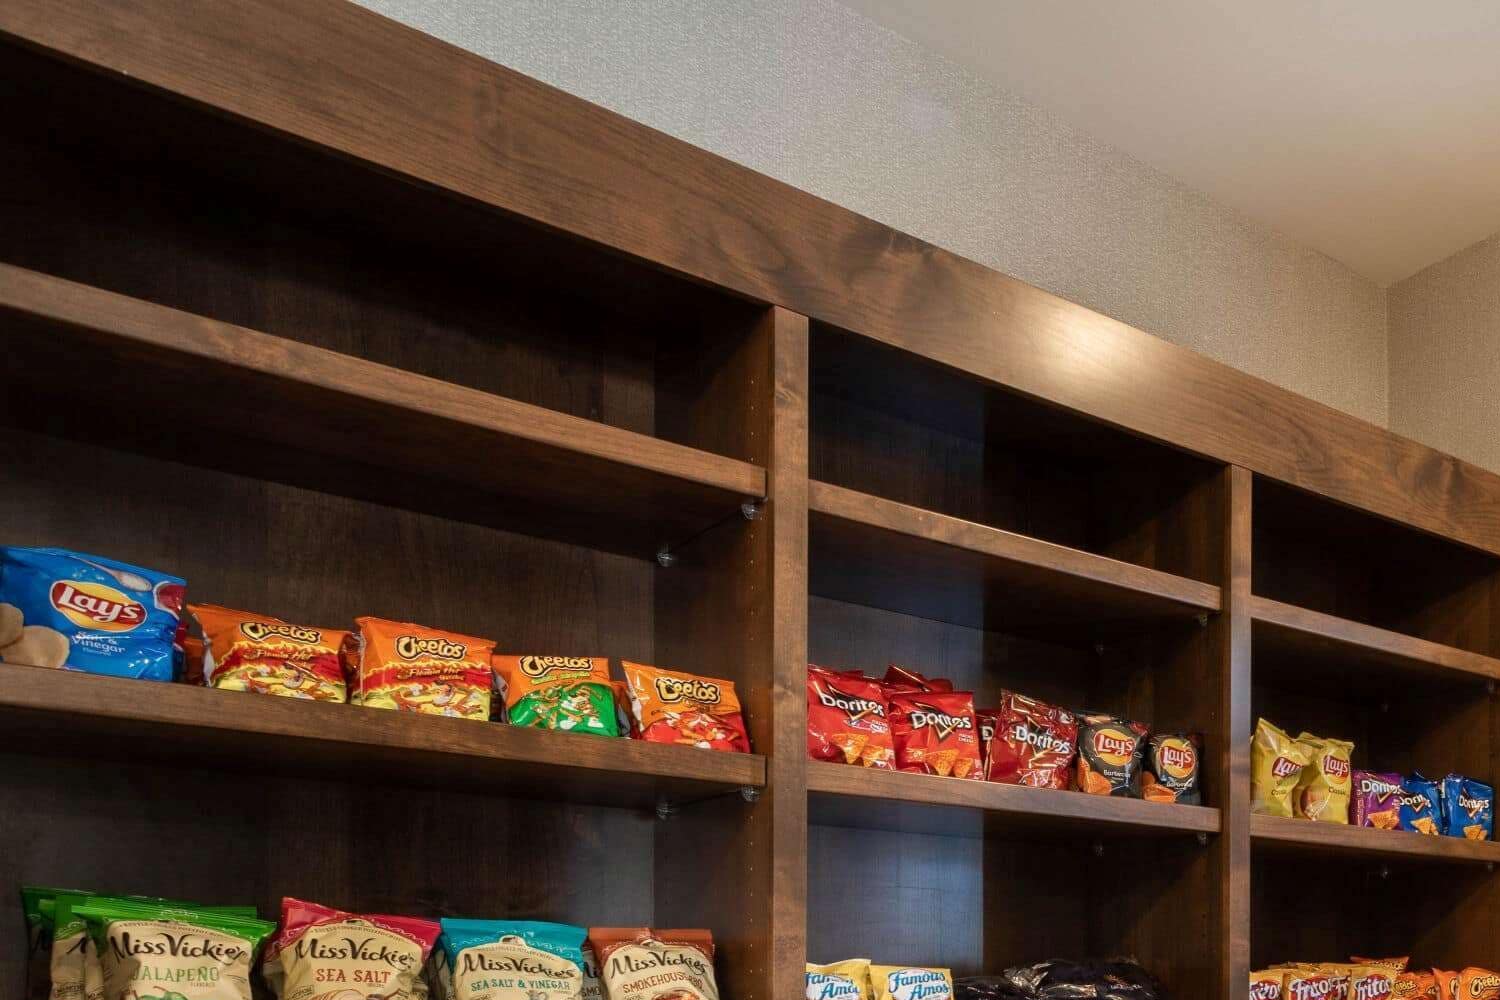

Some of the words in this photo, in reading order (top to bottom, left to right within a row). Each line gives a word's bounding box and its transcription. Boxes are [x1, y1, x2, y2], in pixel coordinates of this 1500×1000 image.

[57, 585, 140, 623] Lay's
[71, 635, 126, 653] Vinegar
[241, 622, 321, 643] Cheetos
[397, 636, 467, 660] Cheetos
[821, 692, 885, 717] Doritos
[911, 712, 972, 730] Doritos
[1015, 726, 1070, 754] Doritos
[1098, 734, 1134, 757] Lay's
[1162, 746, 1192, 767] Lay's
[1458, 795, 1490, 810] Doritos
[110, 932, 165, 963] Miss
[158, 932, 249, 965] Vickie's
[293, 938, 347, 962] Miss
[341, 937, 417, 971] Vickie's
[131, 966, 221, 983] JALAPEÑO
[315, 968, 347, 983] SEA
[353, 970, 392, 983] SALT
[461, 953, 511, 977] Miss
[610, 955, 656, 979] Miss
[471, 981, 490, 992] SEA
[491, 979, 515, 988] SALT
[517, 979, 526, 989] &
[529, 979, 571, 991] VINEGAR
[888, 969, 945, 993] Famous
